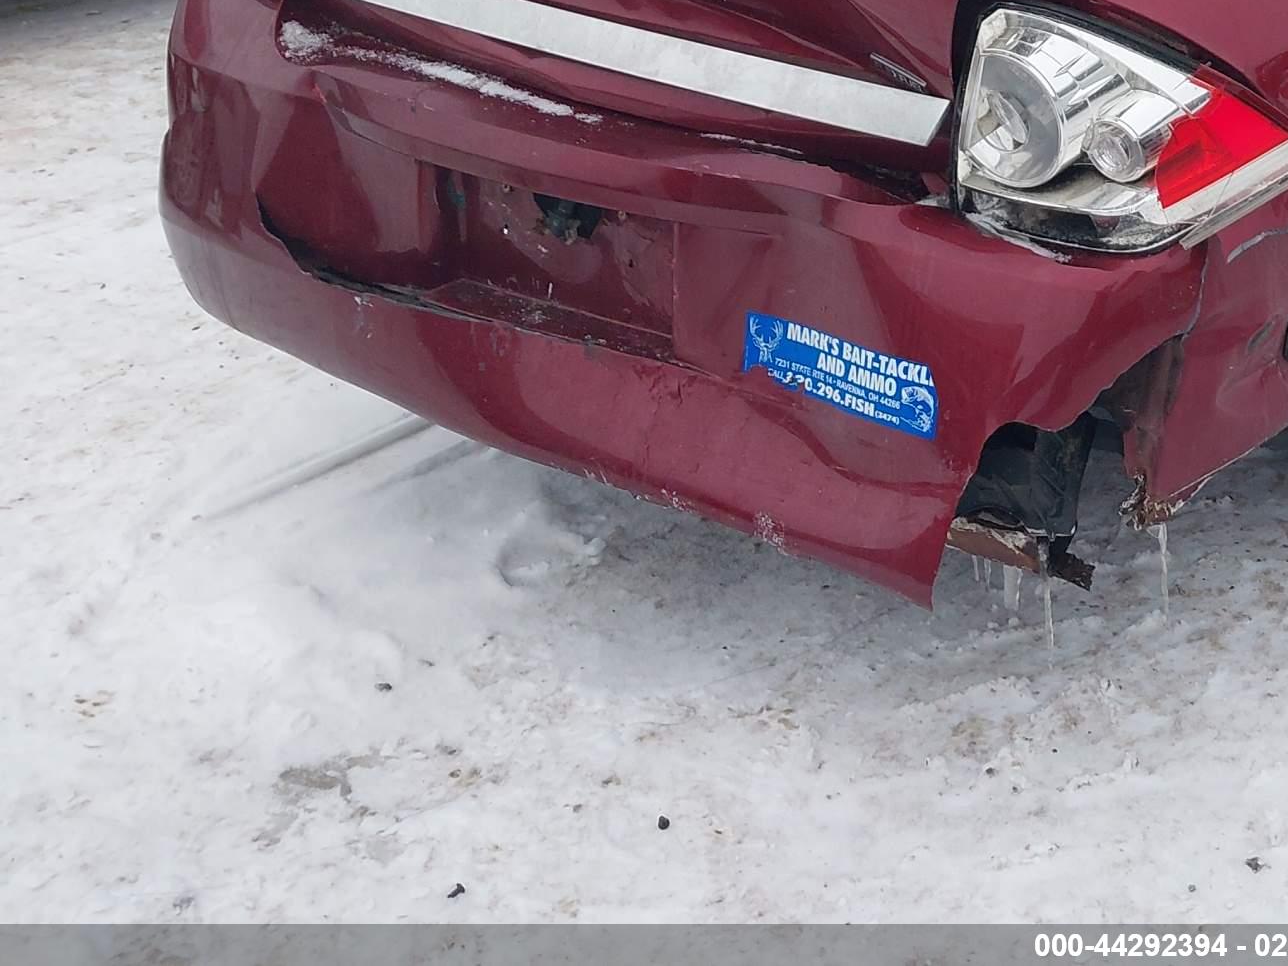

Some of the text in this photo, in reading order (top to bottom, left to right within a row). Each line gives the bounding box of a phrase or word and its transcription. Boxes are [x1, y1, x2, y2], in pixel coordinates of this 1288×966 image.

[786, 322, 840, 356] MARK'S
[791, 362, 811, 376] STATE
[812, 369, 825, 381] RTE
[868, 392, 879, 403] OH
[816, 353, 897, 396] AND AMMO
